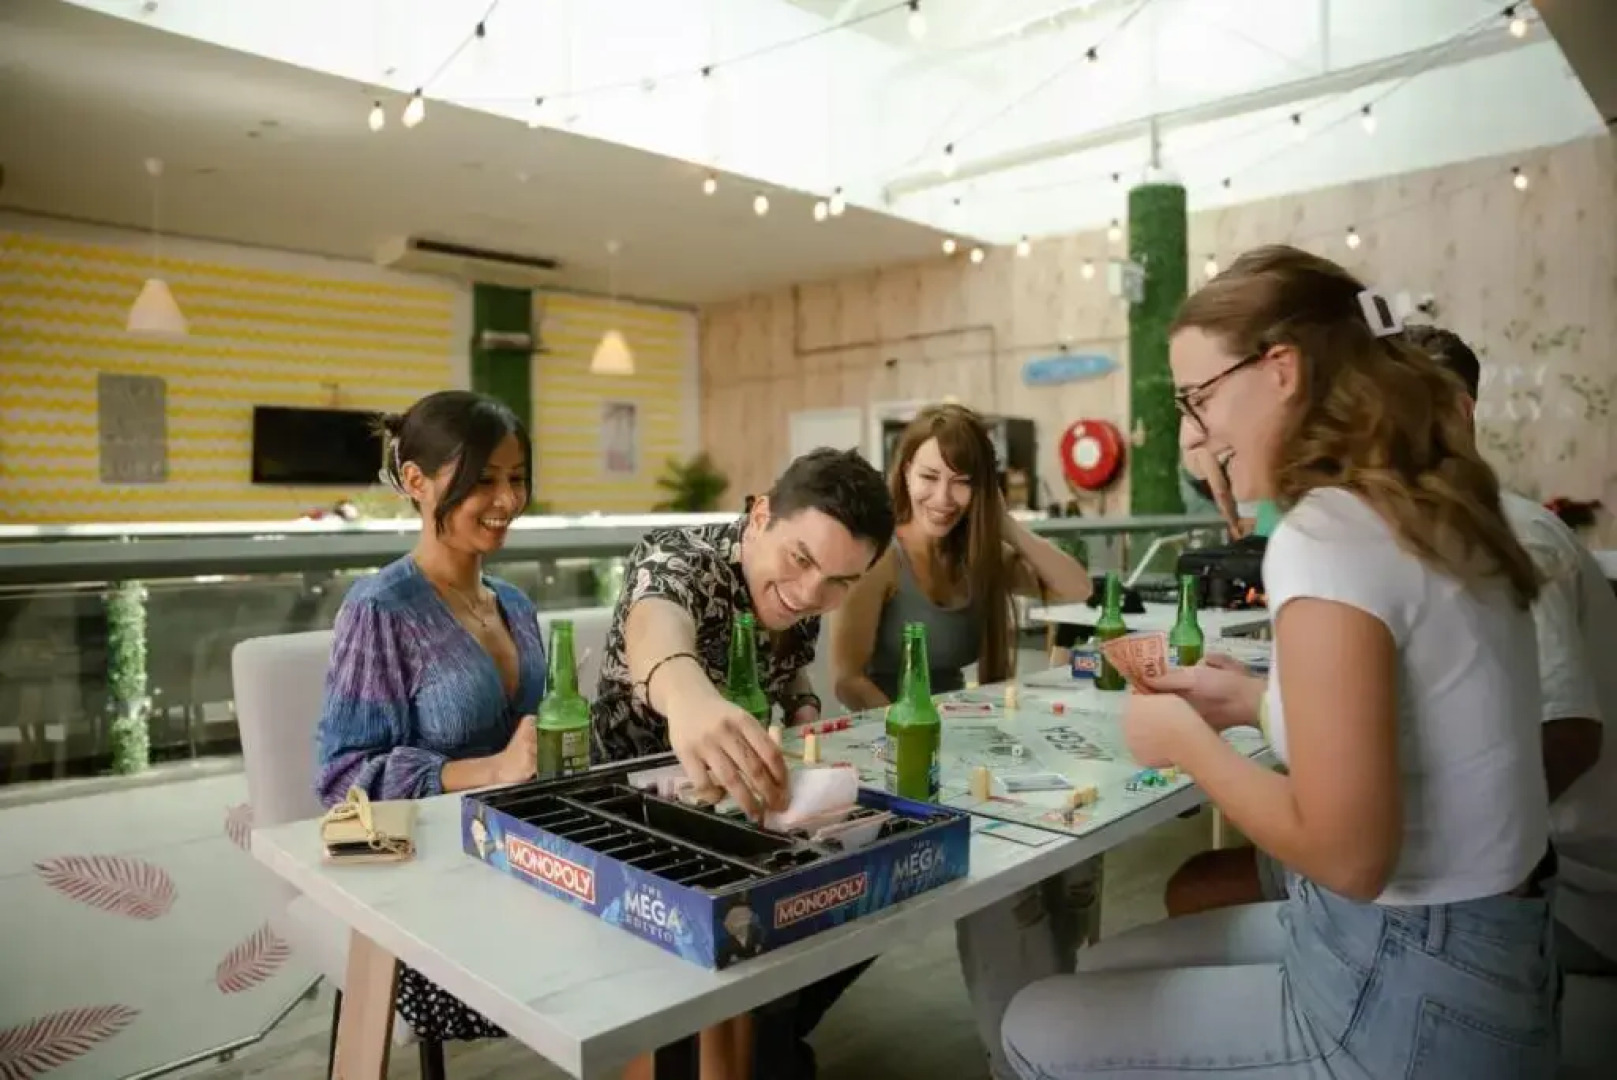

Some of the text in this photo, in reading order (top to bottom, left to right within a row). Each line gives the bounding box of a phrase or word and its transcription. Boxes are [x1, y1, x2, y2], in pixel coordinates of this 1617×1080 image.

[508, 838, 591, 897] MONOPOLY
[893, 847, 946, 879] MEGA
[624, 888, 683, 935] MEGA
[778, 874, 866, 923] MONOPOLY
